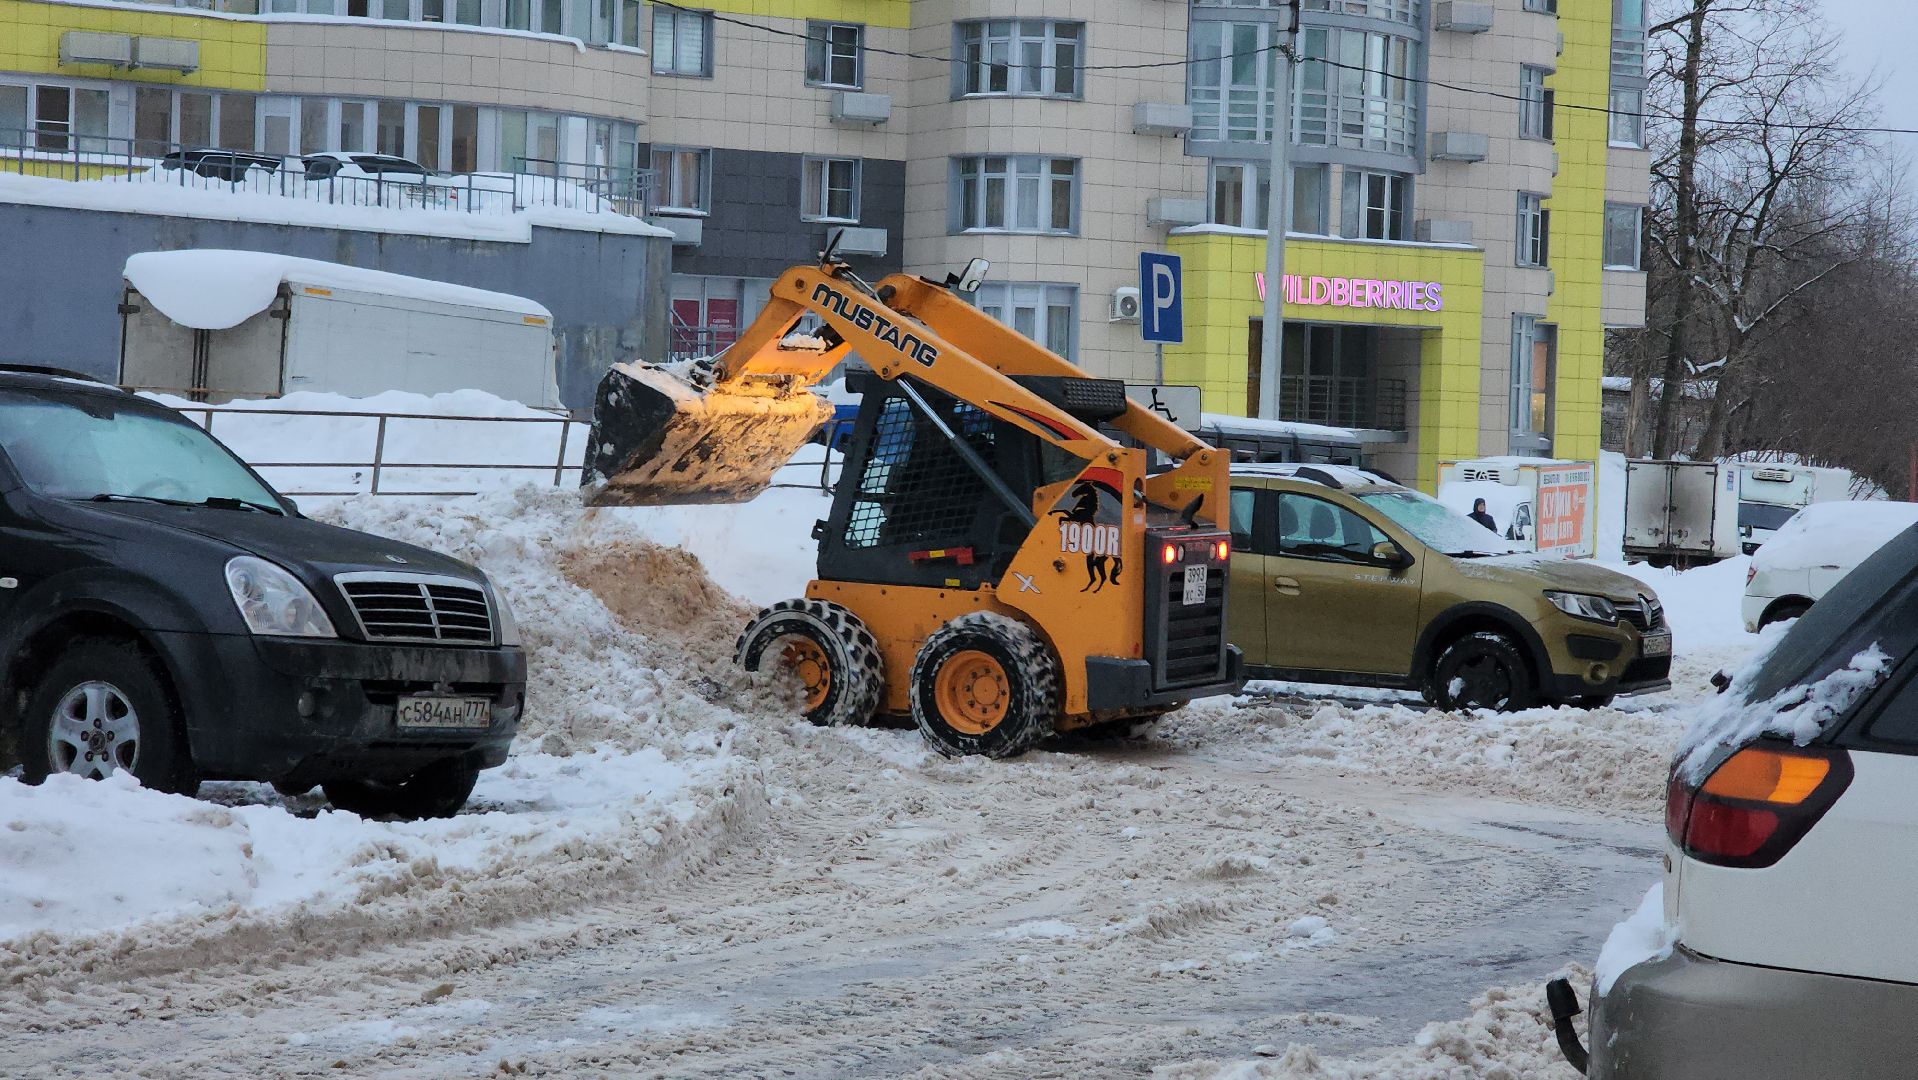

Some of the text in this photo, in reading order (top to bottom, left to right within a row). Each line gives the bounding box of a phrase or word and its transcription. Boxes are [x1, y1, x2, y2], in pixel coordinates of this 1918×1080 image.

[1152, 263, 1175, 333] P
[811, 282, 939, 368] MUSTANG
[1059, 521, 1121, 557] 1900R
[464, 701, 486, 718] 777
